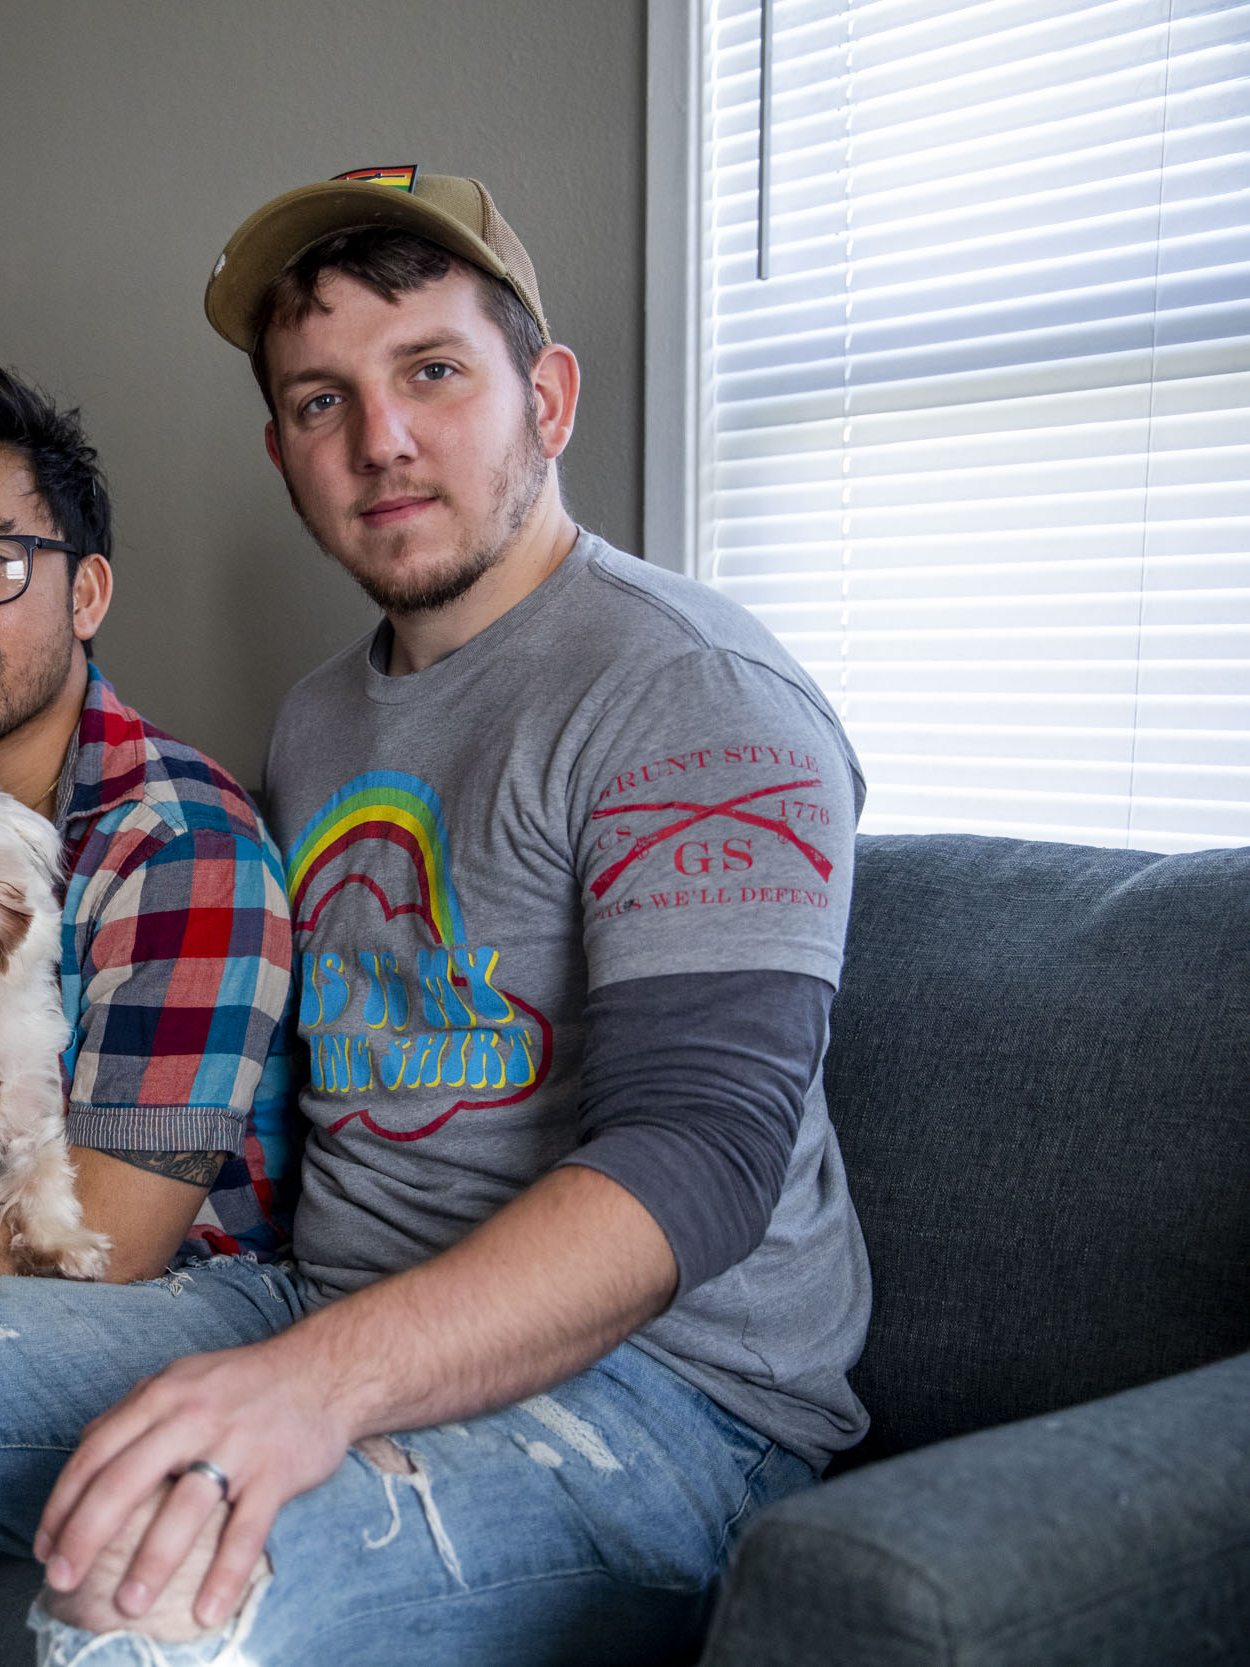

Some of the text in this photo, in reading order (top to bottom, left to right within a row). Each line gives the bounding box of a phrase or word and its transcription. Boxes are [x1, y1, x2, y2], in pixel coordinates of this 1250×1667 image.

[724, 746, 820, 773] STYLE
[778, 799, 830, 825] 1776
[673, 838, 754, 876] GS
[651, 887, 733, 909] WE'LL
[741, 887, 829, 909] DEFEND
[417, 946, 515, 1028] MY
[380, 1025, 537, 1091] SHIRT
